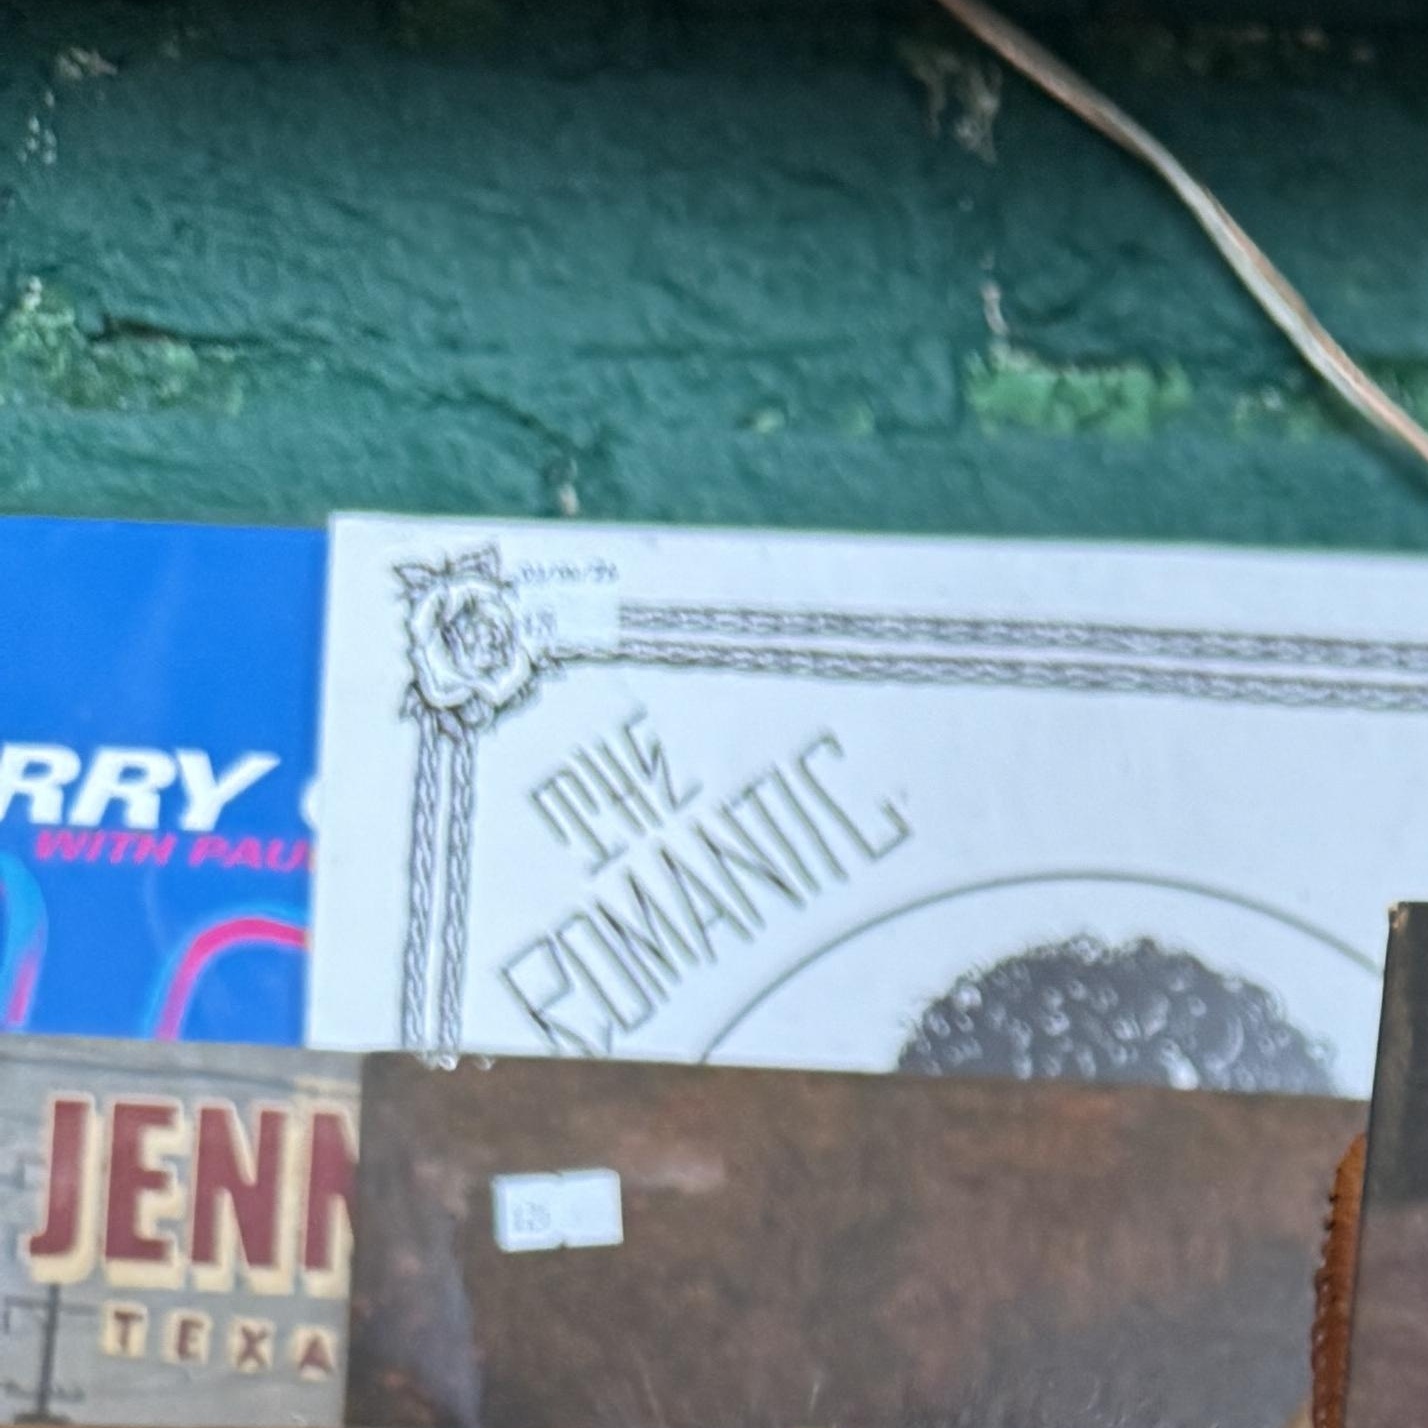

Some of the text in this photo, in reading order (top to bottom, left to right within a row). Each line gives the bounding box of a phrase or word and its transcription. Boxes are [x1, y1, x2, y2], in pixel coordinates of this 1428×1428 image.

[35, 829, 317, 872] WITH PAU
[528, 703, 703, 875] THE
[500, 728, 912, 1055] ROMANTIC
[102, 1303, 341, 1381] TEXA
